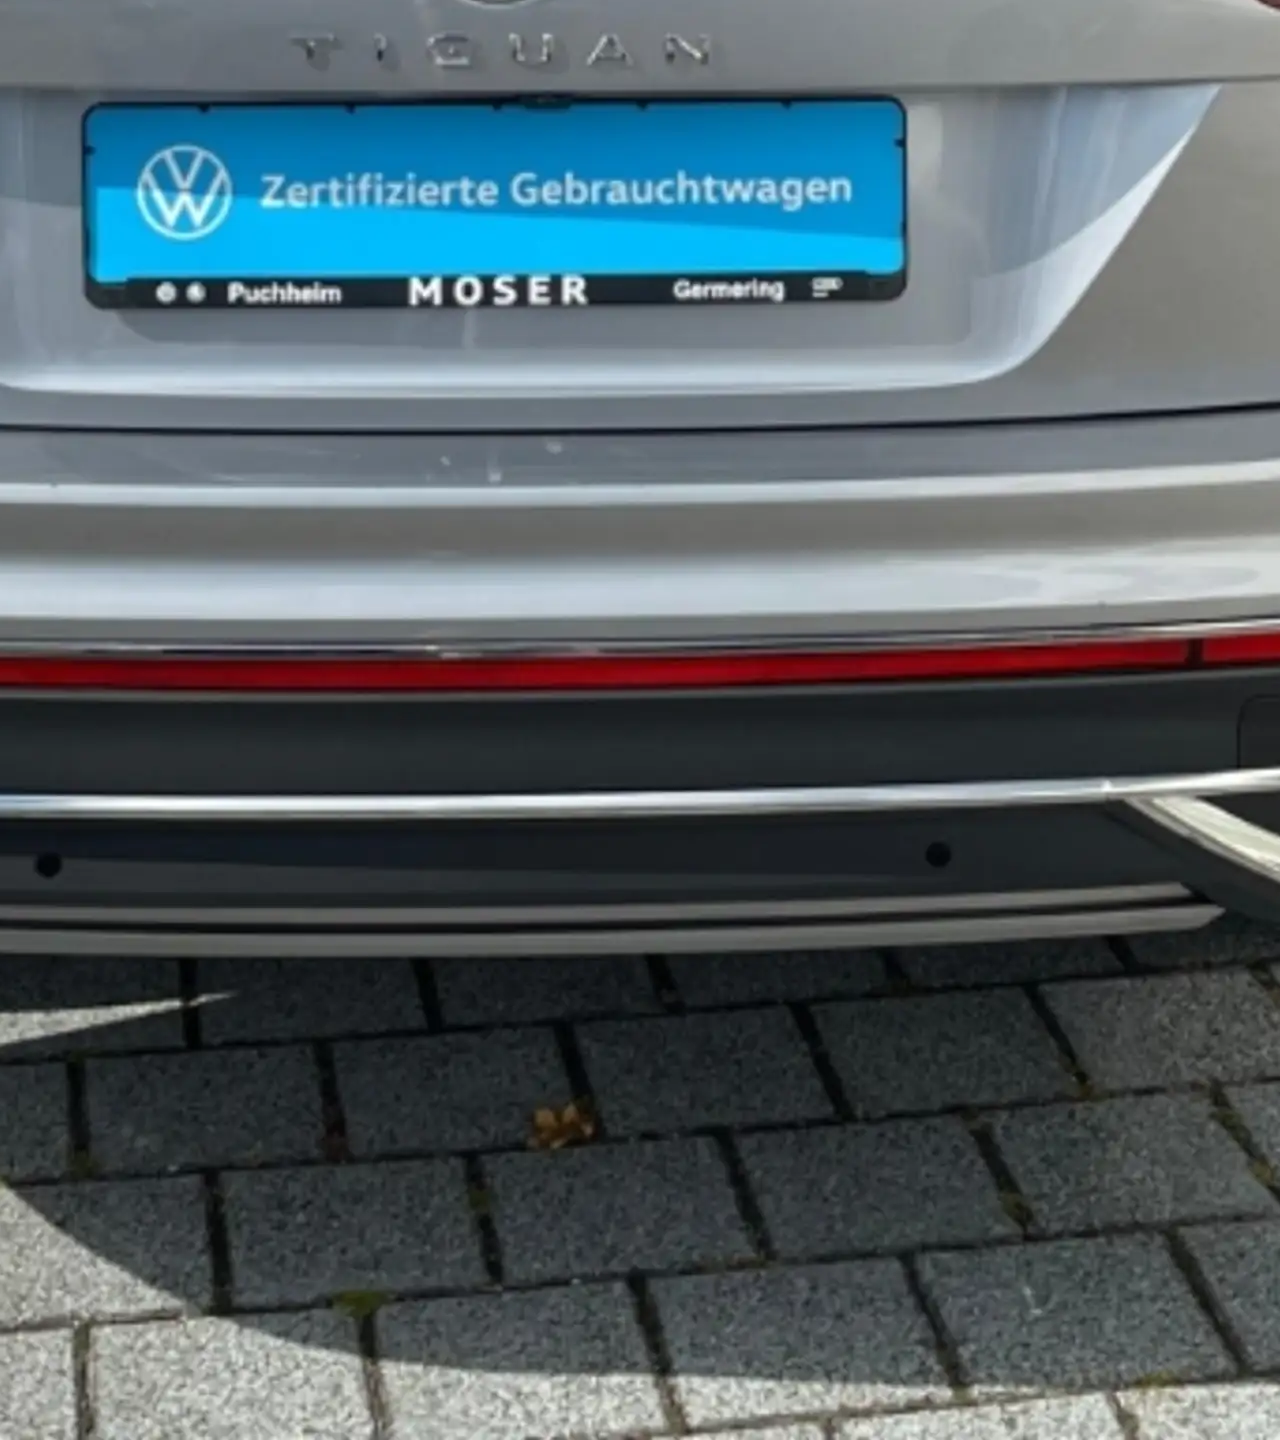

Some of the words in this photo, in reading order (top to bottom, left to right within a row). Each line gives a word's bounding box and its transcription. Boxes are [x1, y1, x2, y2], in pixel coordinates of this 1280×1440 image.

[290, 32, 712, 68] TIGUAN
[260, 172, 499, 208] Zertifizierte
[510, 171, 852, 212] Gebrauchtwagen
[227, 281, 342, 304] Puchheim
[408, 276, 588, 306] MOSER
[673, 278, 785, 302] Germering
